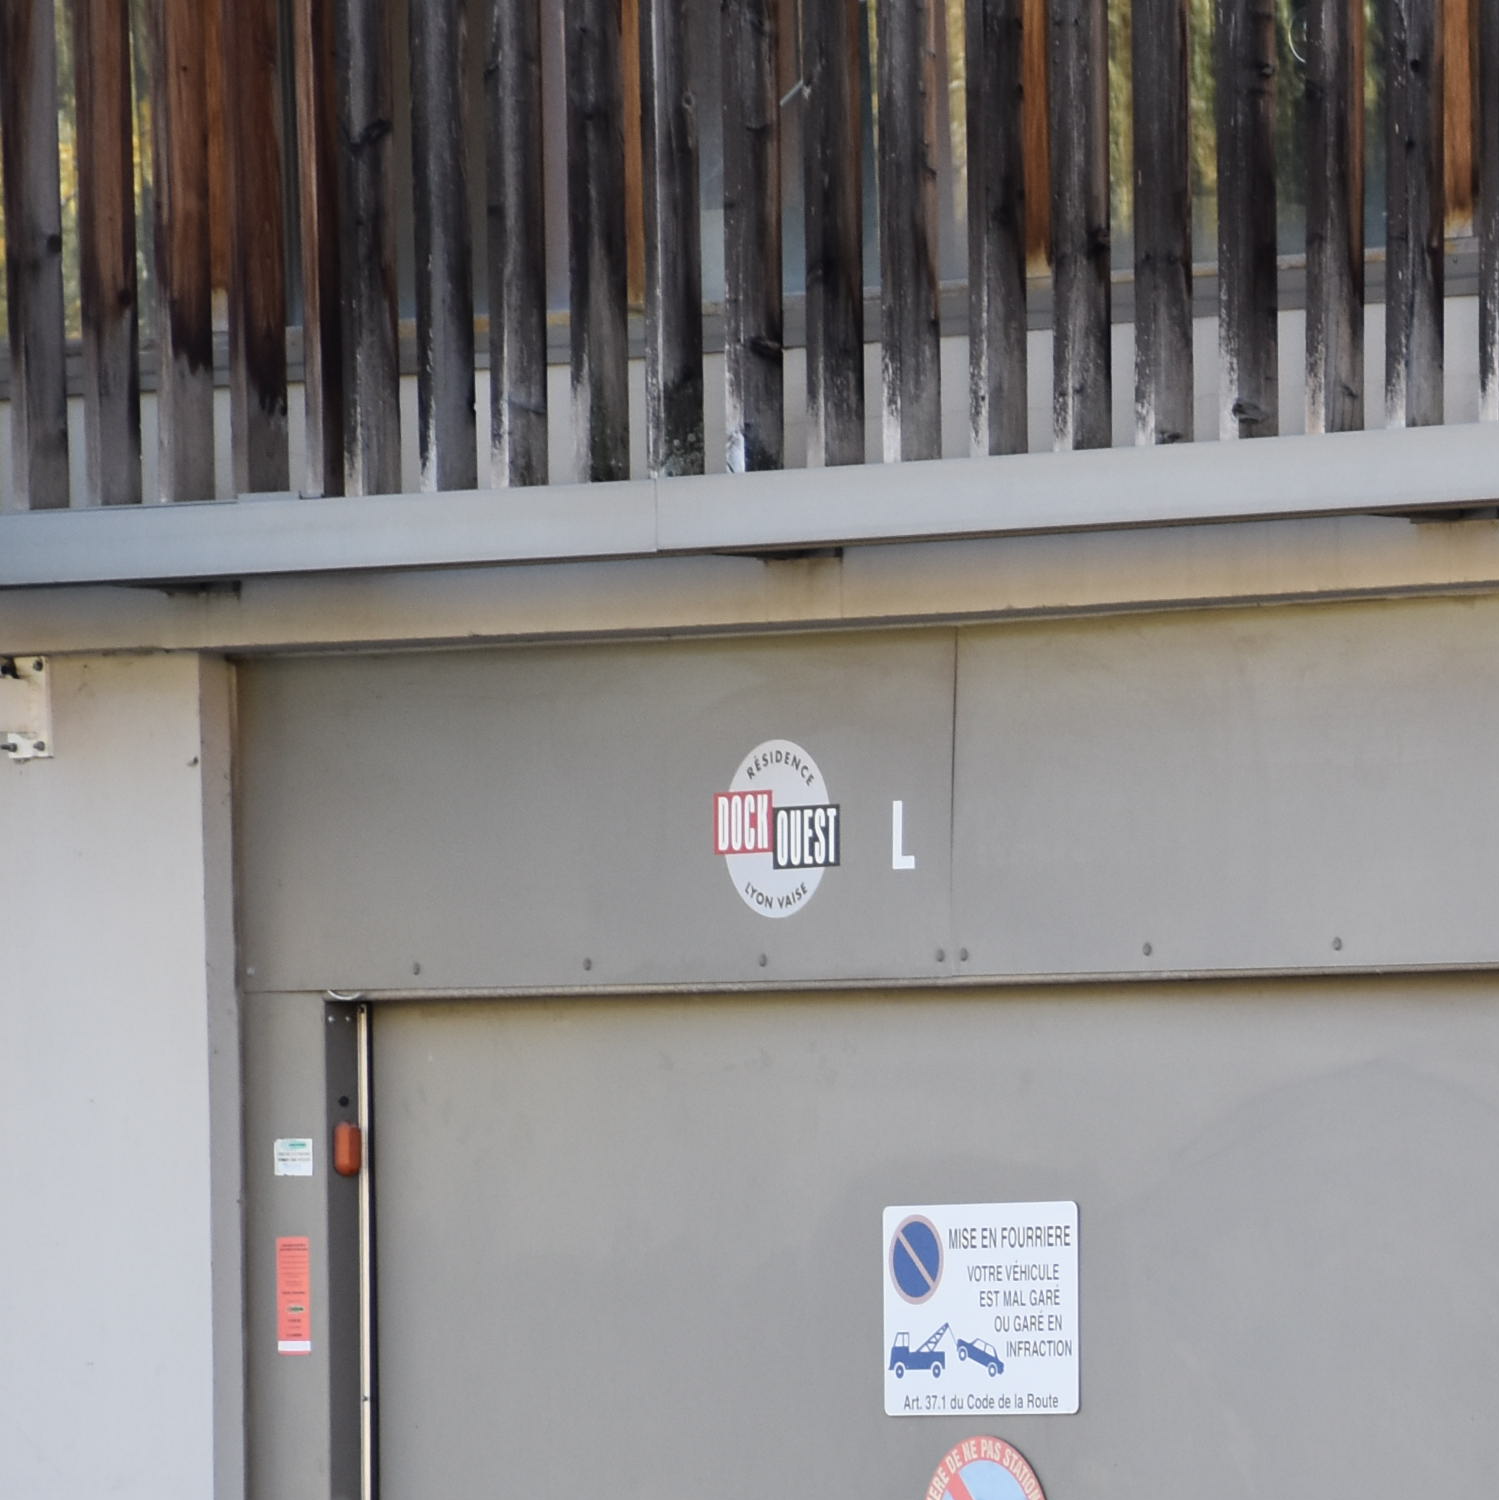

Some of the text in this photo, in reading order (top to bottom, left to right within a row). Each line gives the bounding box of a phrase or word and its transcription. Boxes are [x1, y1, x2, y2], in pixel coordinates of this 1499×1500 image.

[746, 750, 815, 787] RÉSIDENCE
[717, 793, 837, 867] DOCK OUEST
[892, 800, 916, 870] L
[744, 881, 809, 910] LYON VAISE
[948, 1225, 1072, 1250] MISE EN FOURRIERE
[967, 1259, 1060, 1282] VOTRE VÉHICULE
[979, 1284, 1062, 1308] EST MAL GARÉ
[994, 1309, 1063, 1333] OU GARÉ EN
[1006, 1339, 1073, 1359] INFRACTION
[904, 1393, 1060, 1411] Art. 37.1 du Code de la Route
[945, 1449, 963, 1474] DE
[961, 1439, 979, 1460] NE
[980, 1439, 1003, 1460] PAS
